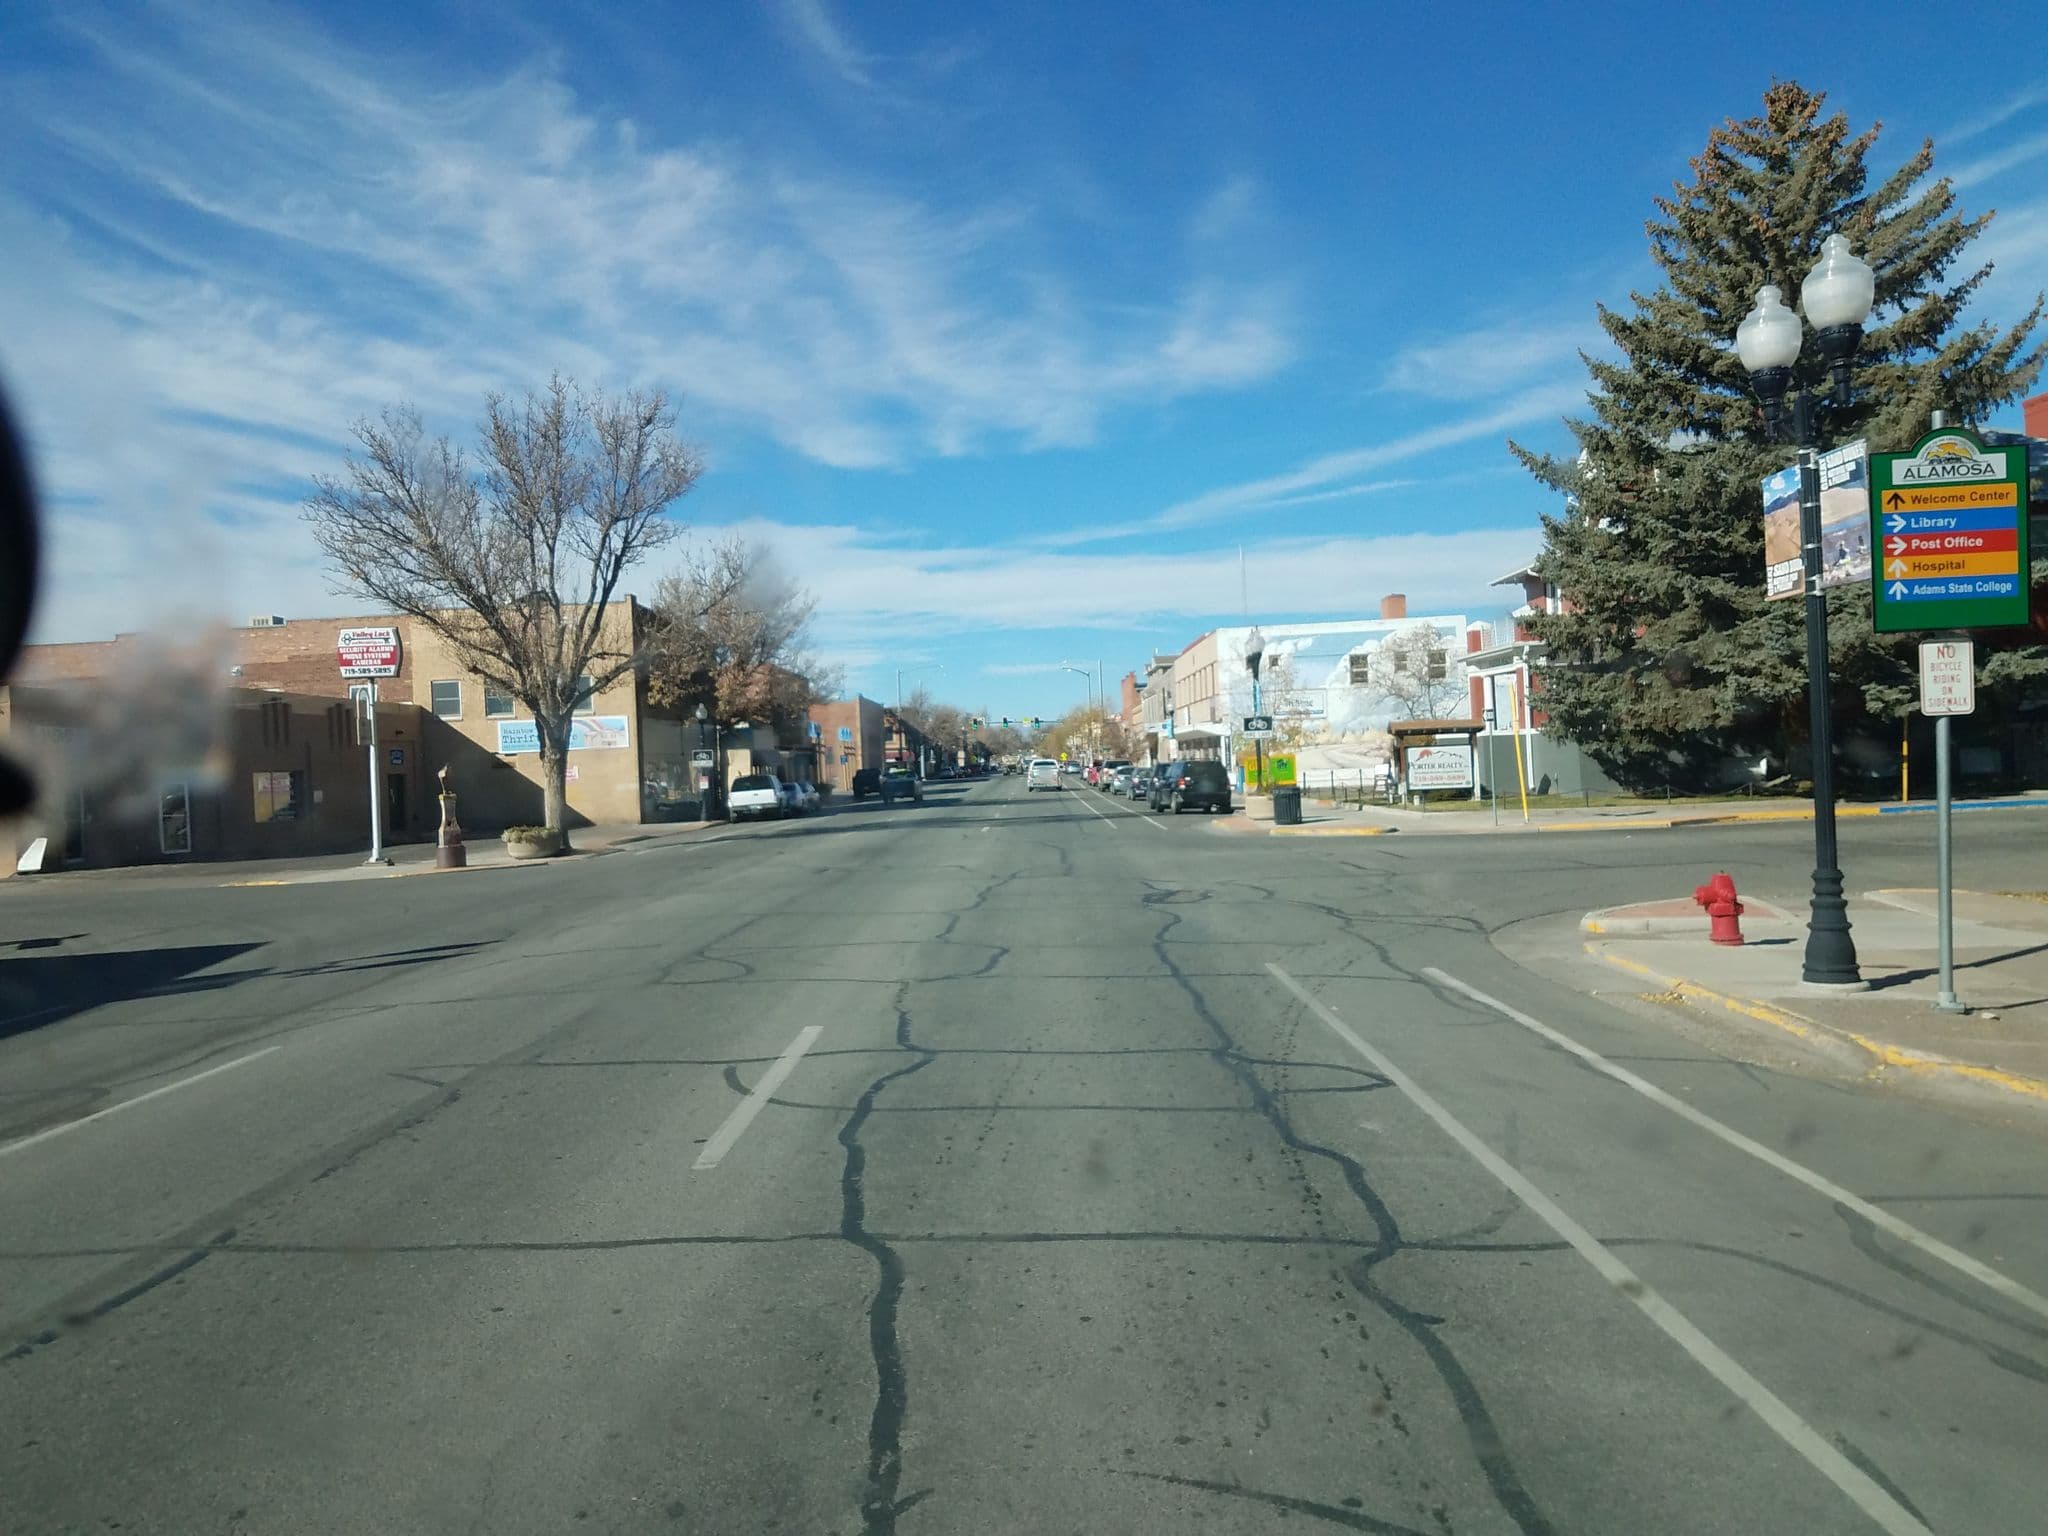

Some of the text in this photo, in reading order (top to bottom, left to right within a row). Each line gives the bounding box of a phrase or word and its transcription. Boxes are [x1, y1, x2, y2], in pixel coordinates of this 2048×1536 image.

[1903, 463, 1996, 479] ALAMOSA
[1910, 491, 2010, 505] Welcome Center
[1910, 517, 1957, 529] Library
[1911, 536, 1984, 550] Post Office
[1912, 560, 1965, 573] Hospital
[1912, 581, 2012, 595] Adams State College
[1937, 645, 1955, 659] NO
[1930, 661, 1962, 672] BICYCLE
[1933, 674, 1961, 684] RIDING
[1942, 686, 1953, 695] ON
[1927, 697, 1968, 708] SIDEWALK
[502, 734, 538, 744] Thrif
[1437, 761, 1463, 769] REALTY
